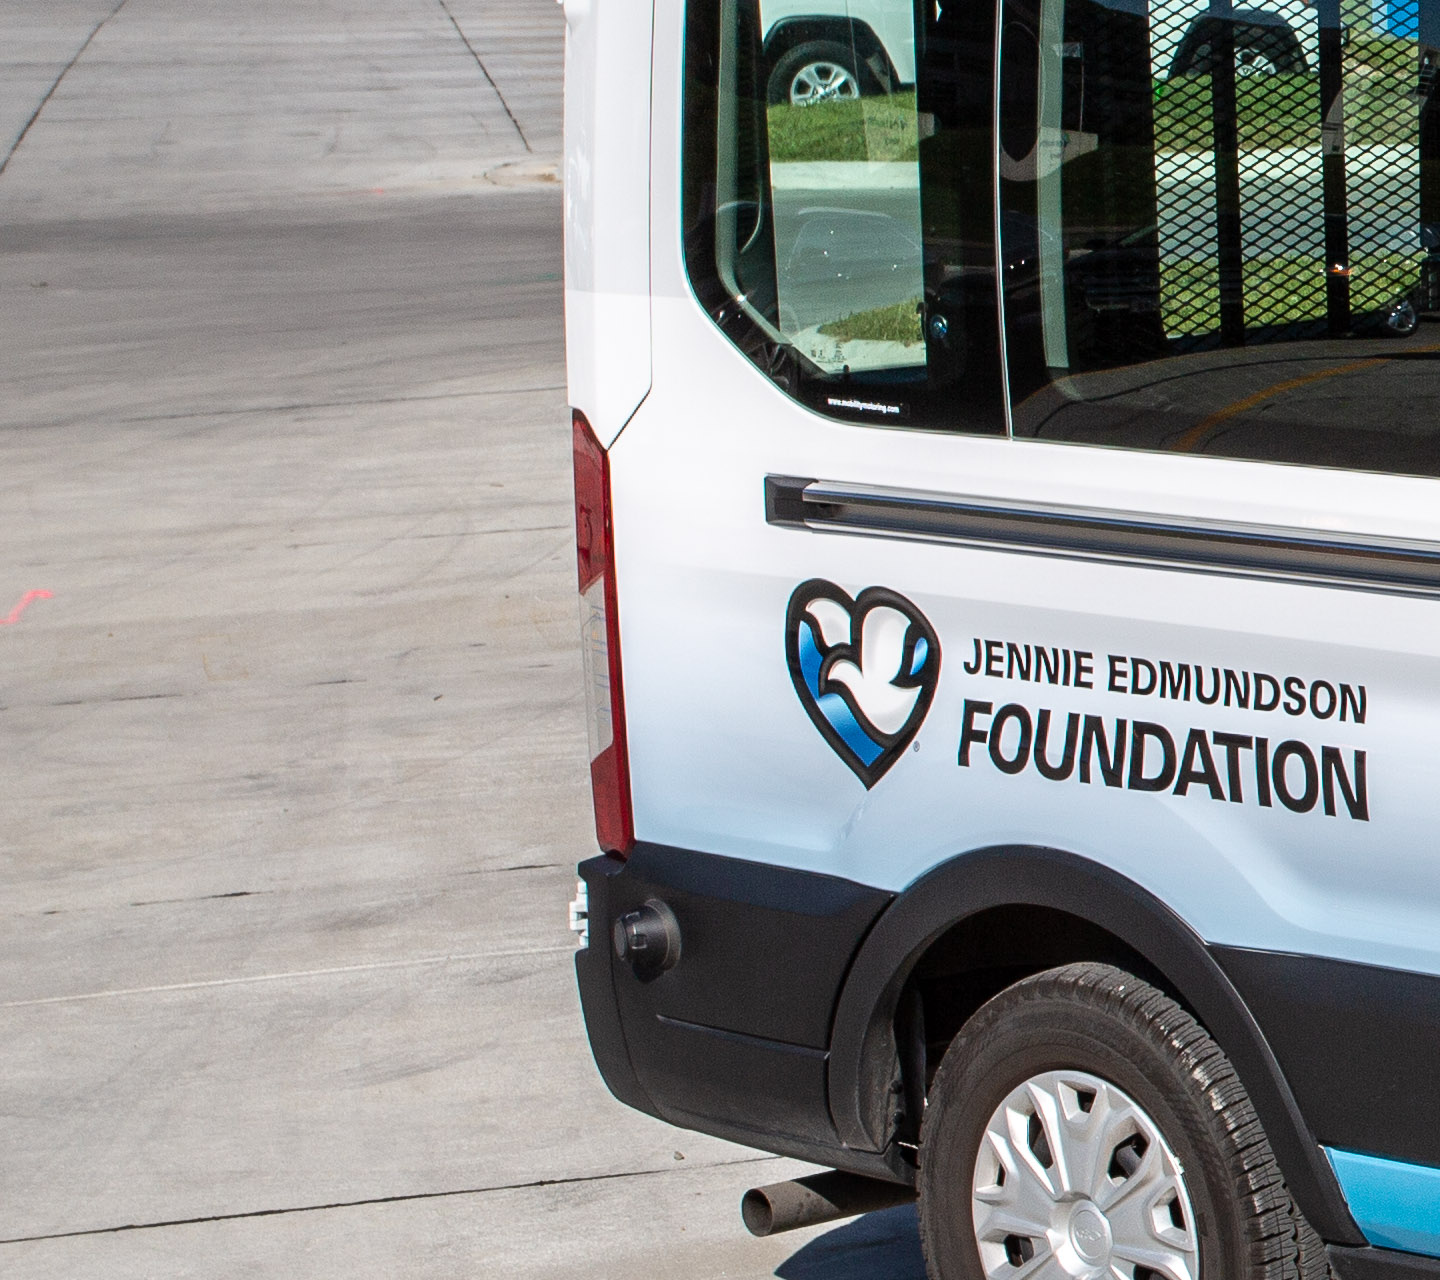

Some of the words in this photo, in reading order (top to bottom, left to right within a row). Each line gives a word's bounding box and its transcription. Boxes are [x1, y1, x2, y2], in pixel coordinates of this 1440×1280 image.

[963, 638, 1093, 690] JENNIE
[1107, 654, 1367, 724] EDMUNDSON
[958, 698, 1370, 822] FOUNDATION
